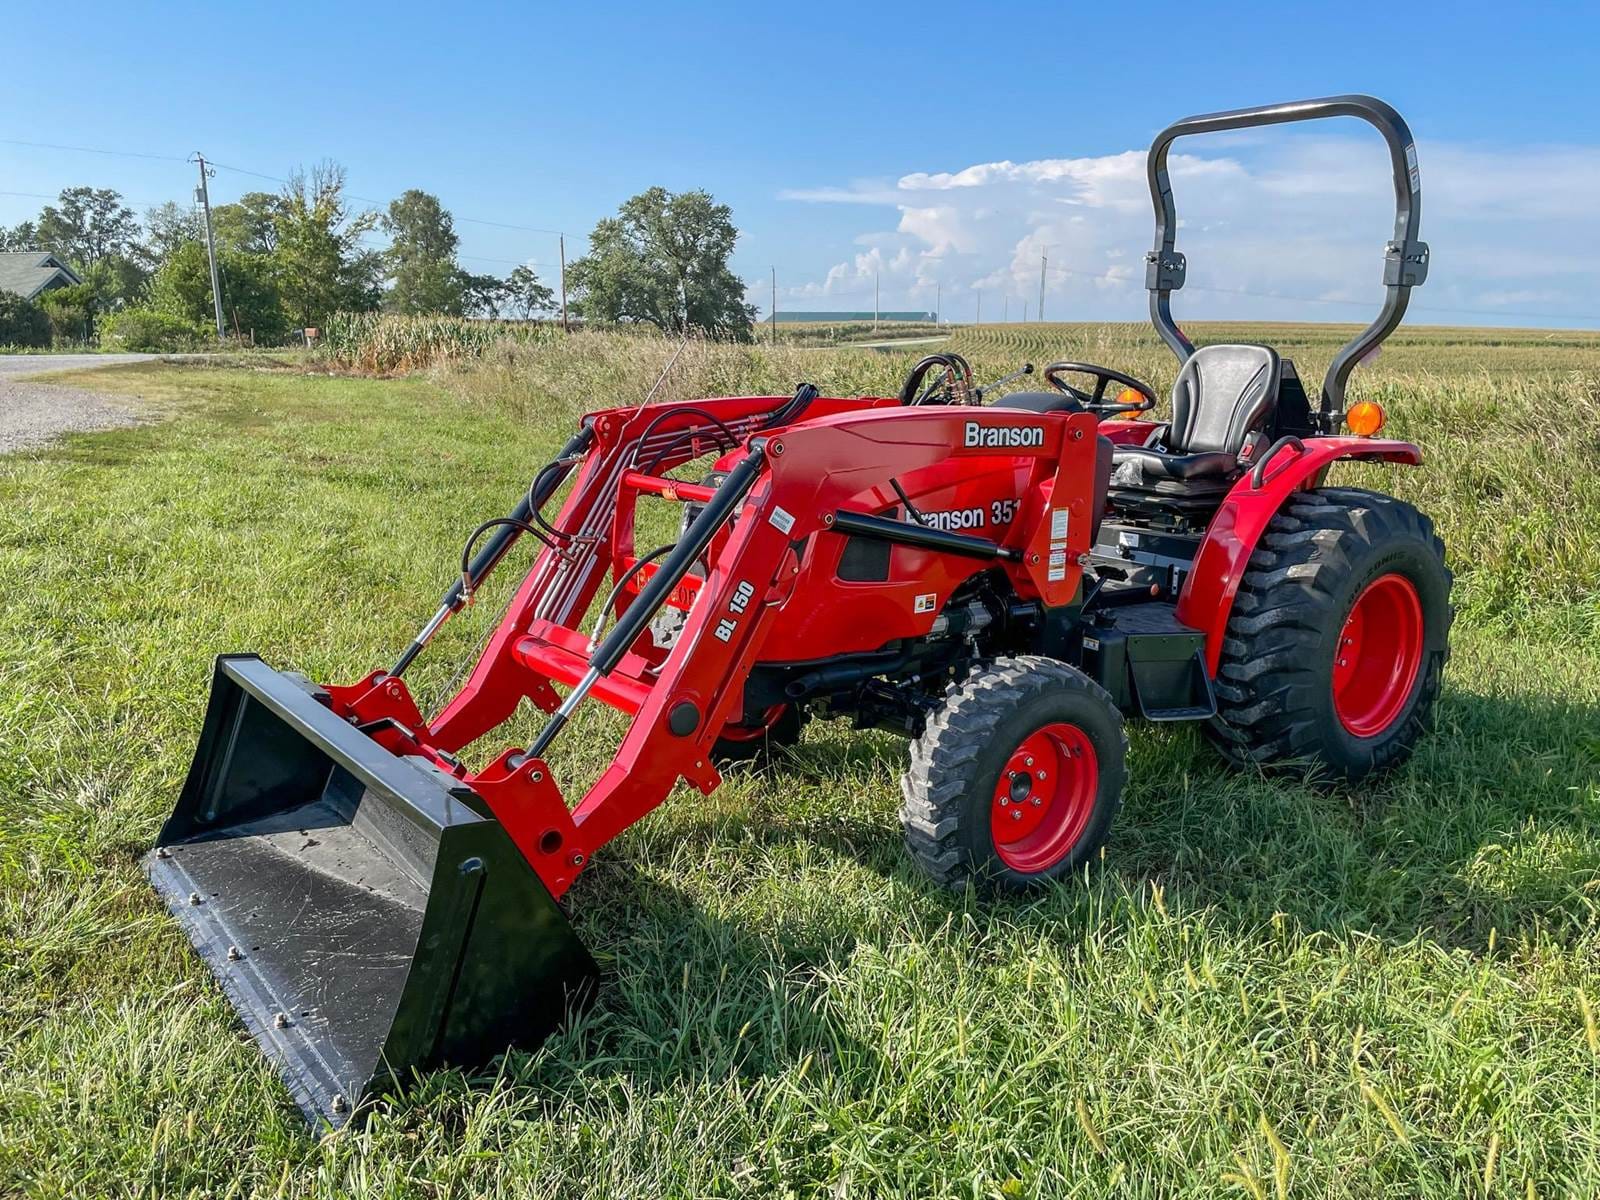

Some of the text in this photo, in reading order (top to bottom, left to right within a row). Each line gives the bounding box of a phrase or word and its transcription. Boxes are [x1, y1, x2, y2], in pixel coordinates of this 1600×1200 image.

[964, 421, 1044, 448] Branson
[714, 580, 755, 643] BL 150
